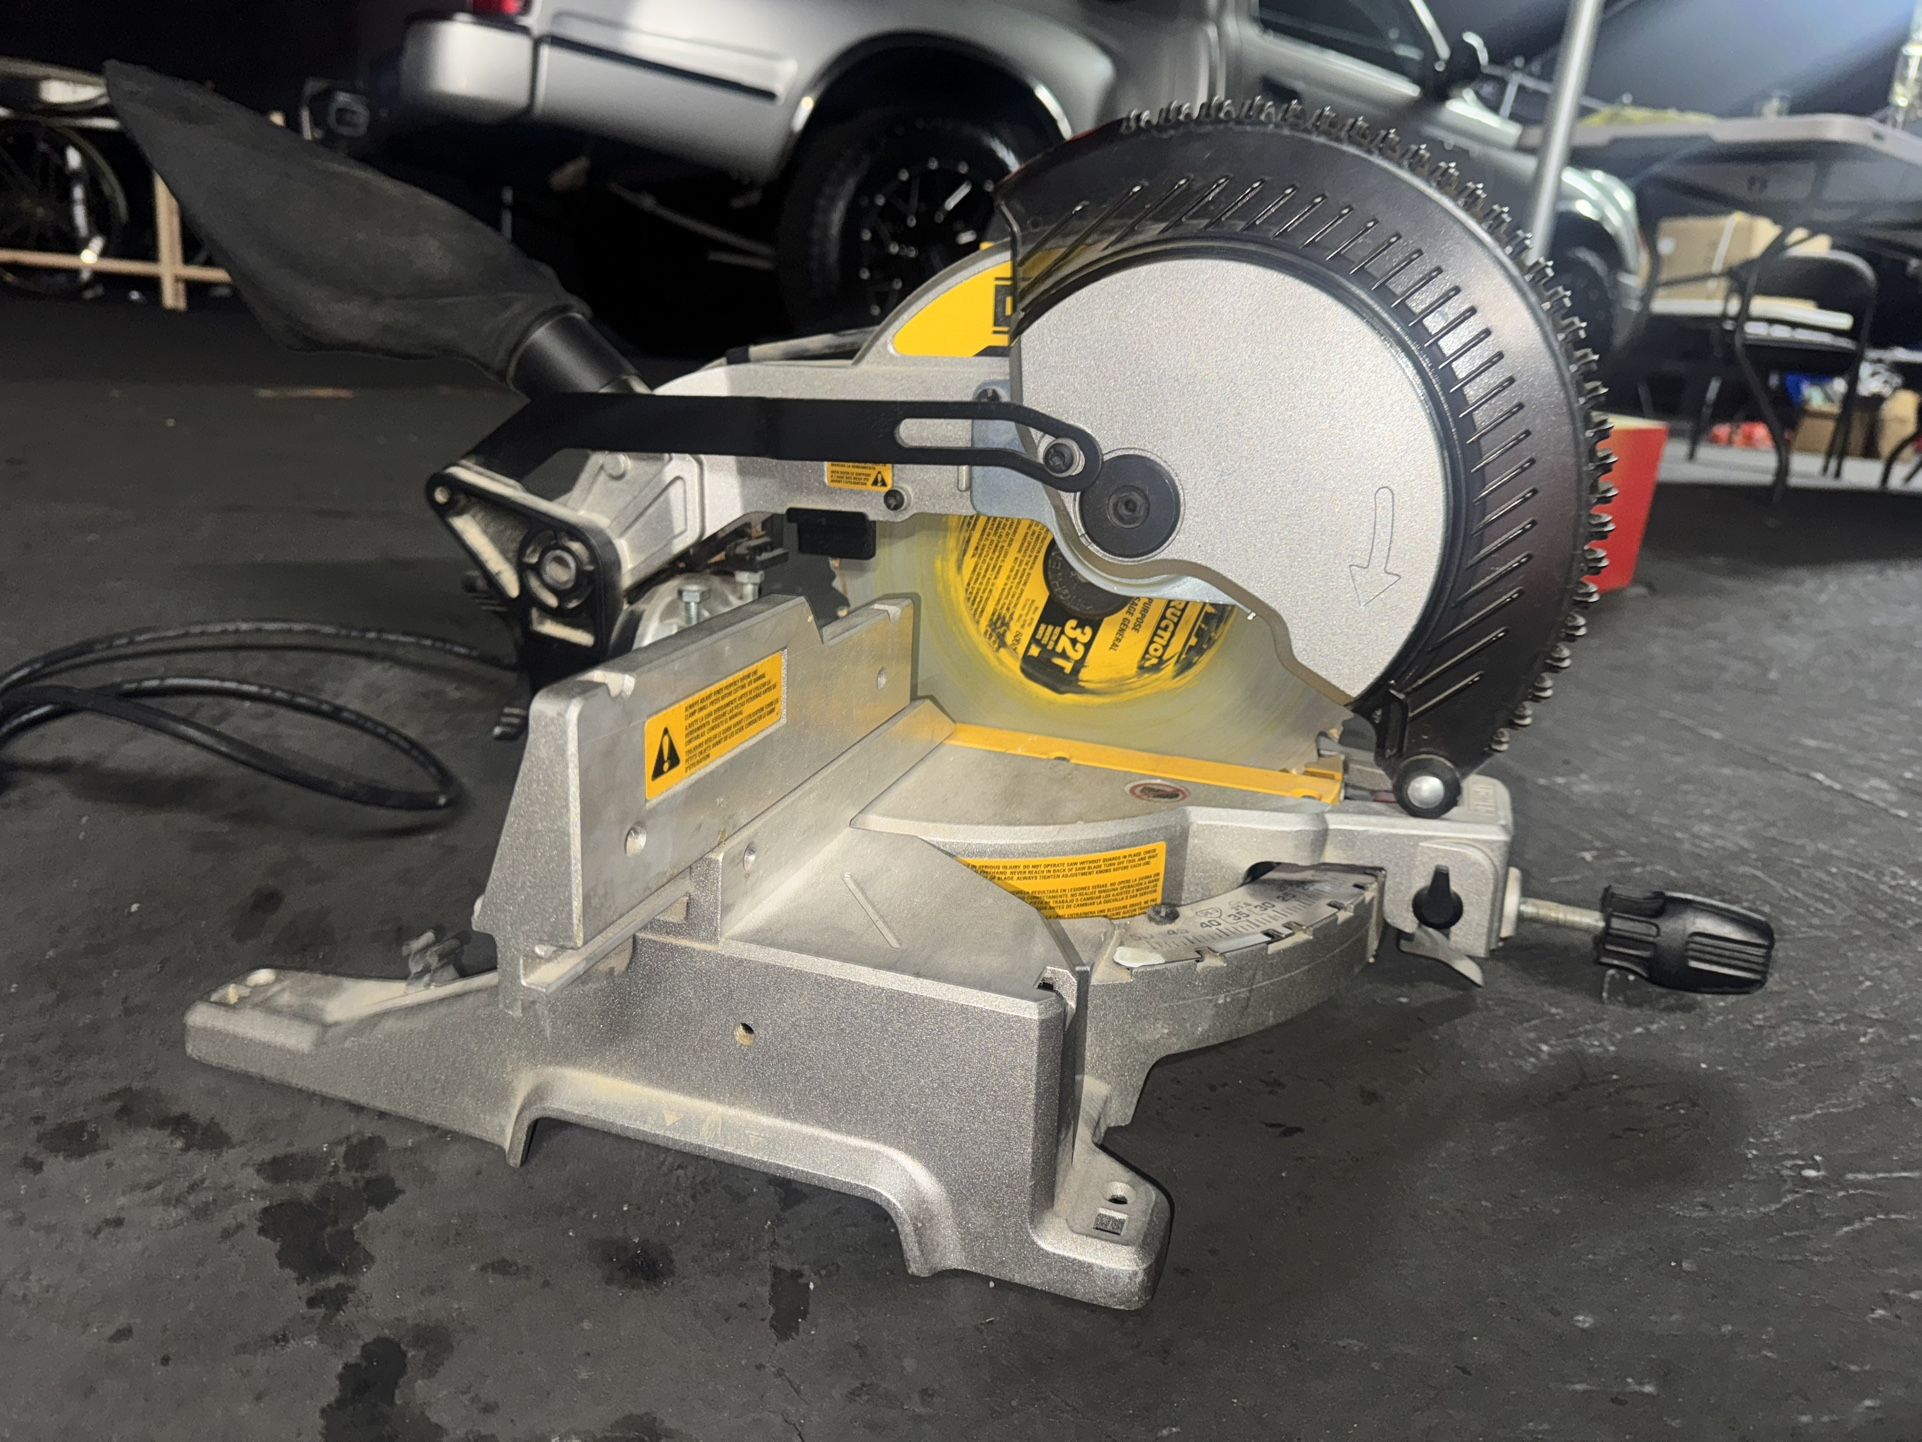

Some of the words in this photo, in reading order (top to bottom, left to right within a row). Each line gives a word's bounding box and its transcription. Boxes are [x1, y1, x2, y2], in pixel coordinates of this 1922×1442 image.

[1131, 598, 1153, 633] PURPOSE
[1052, 618, 1093, 675] 32T
[1200, 919, 1221, 930] 40
[1228, 908, 1250, 922] 35
[1254, 902, 1275, 912] 30
